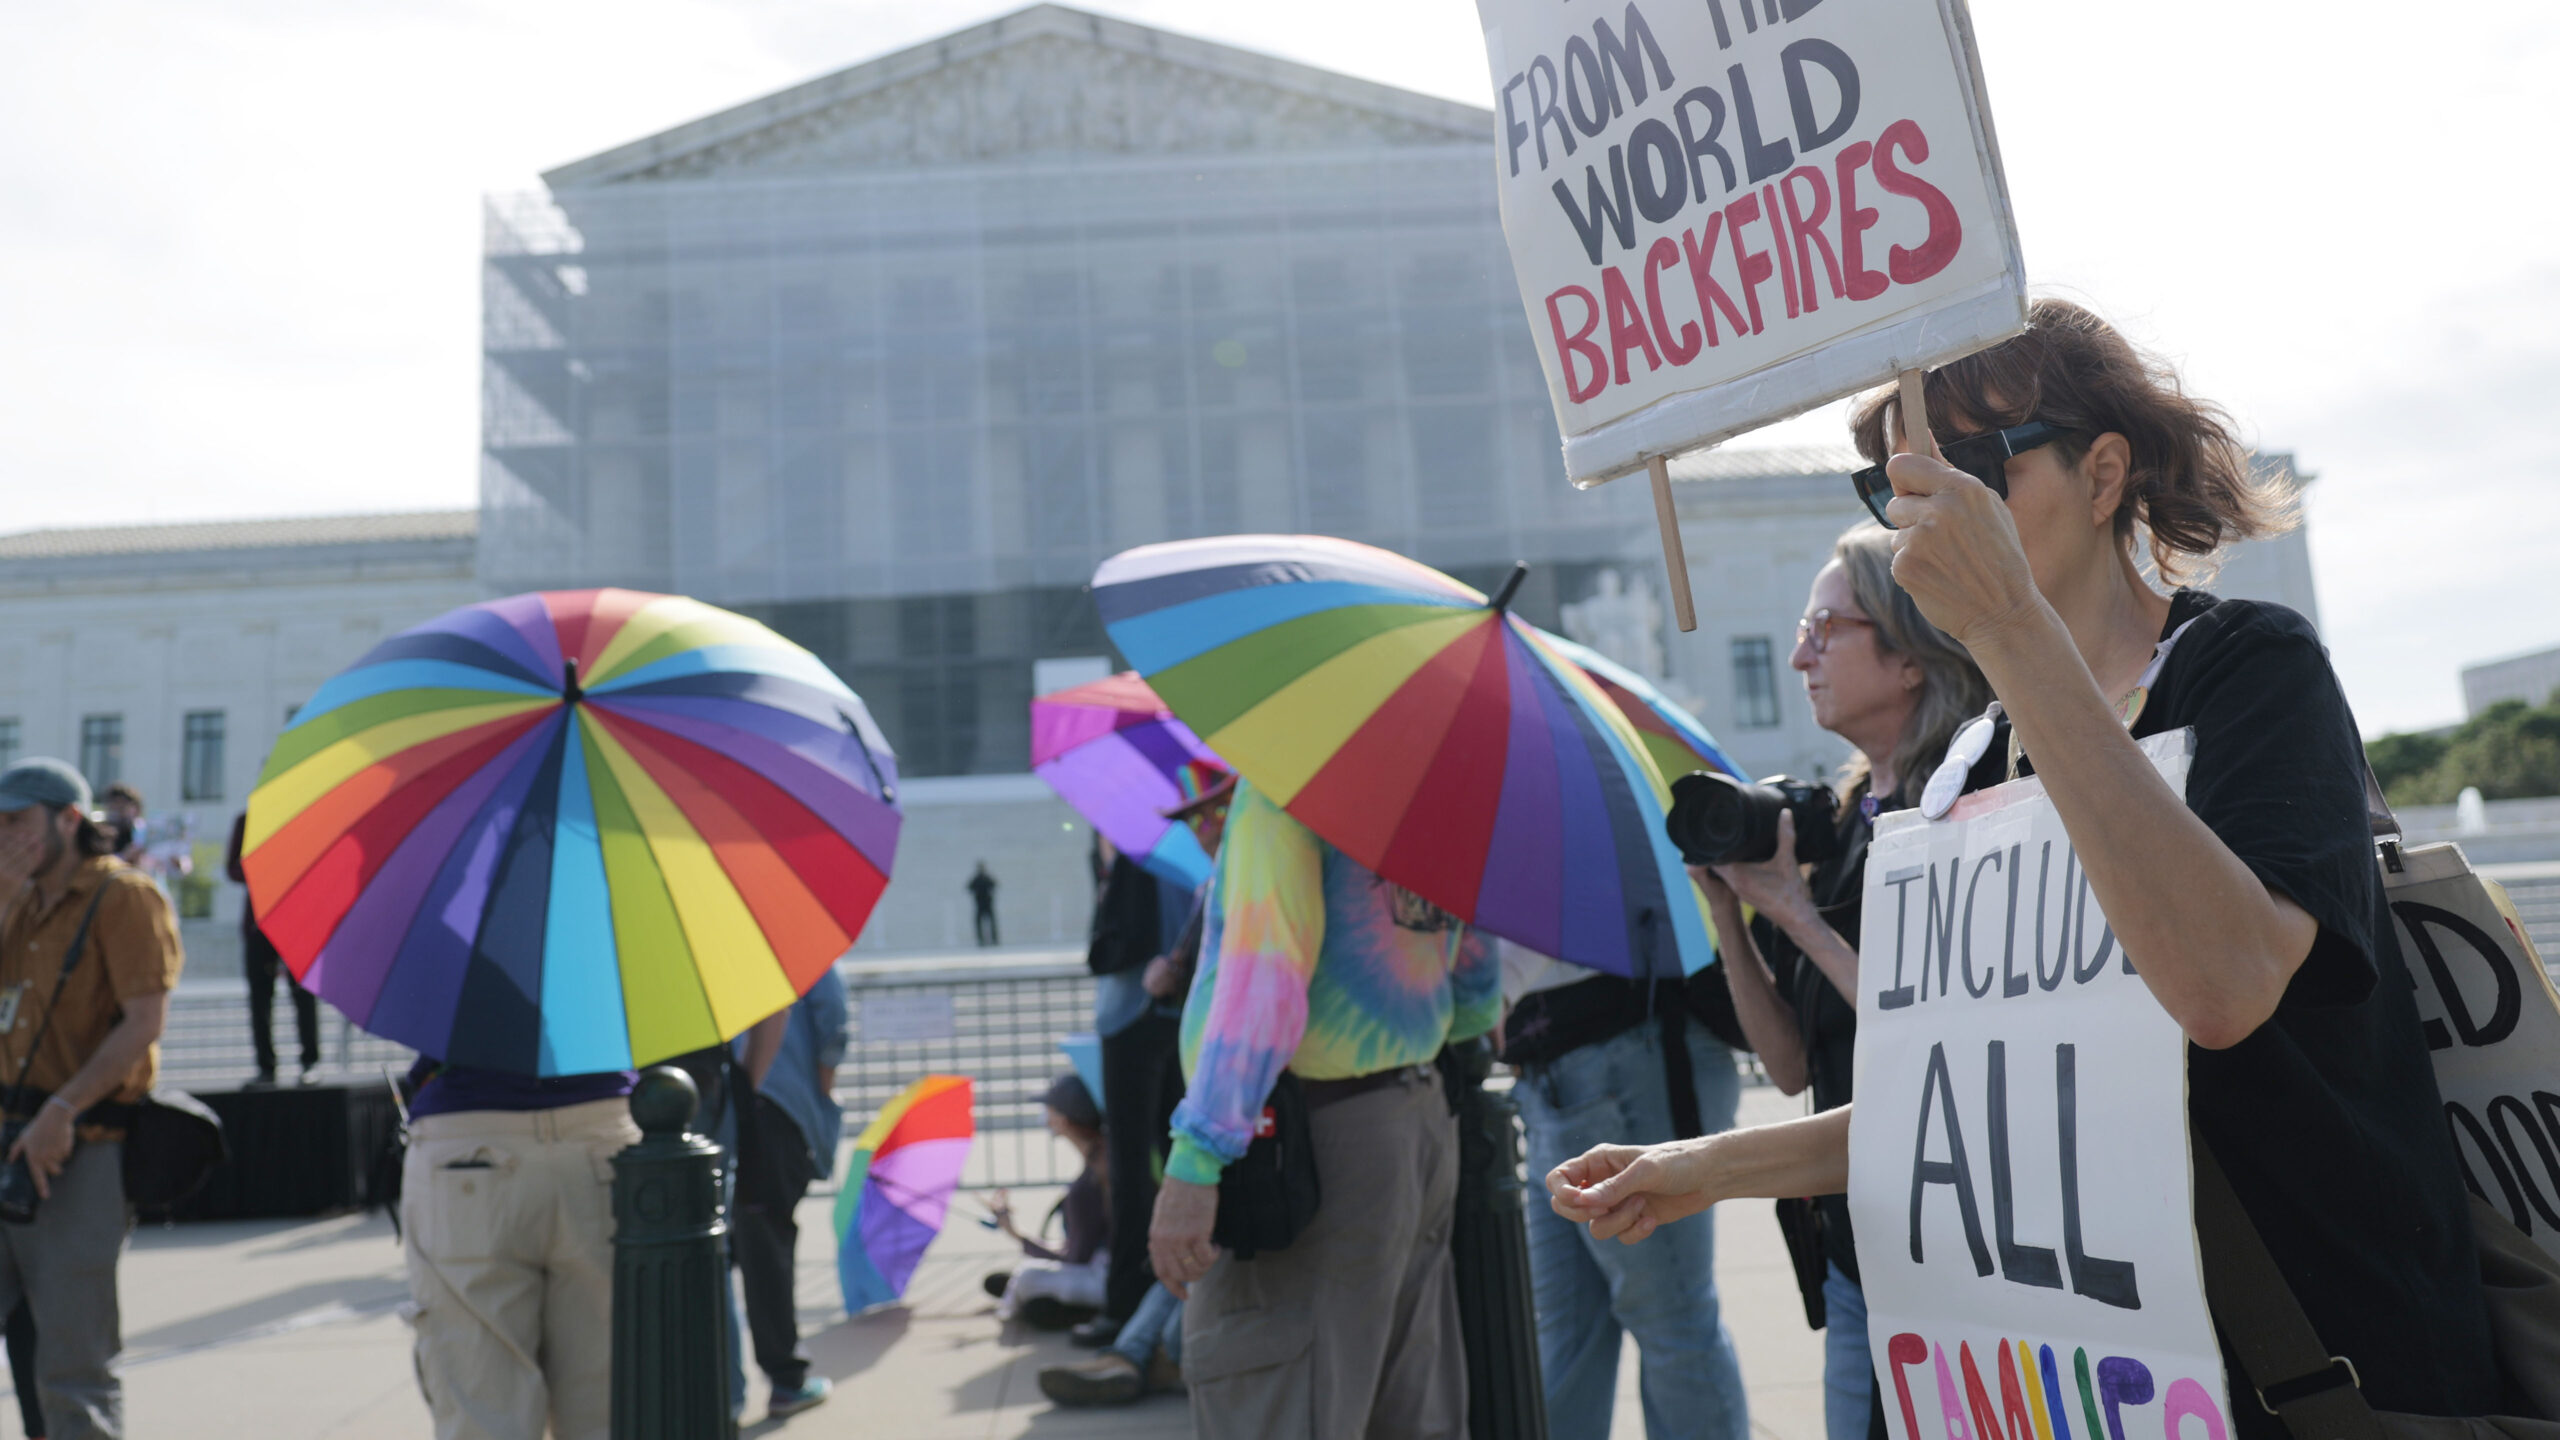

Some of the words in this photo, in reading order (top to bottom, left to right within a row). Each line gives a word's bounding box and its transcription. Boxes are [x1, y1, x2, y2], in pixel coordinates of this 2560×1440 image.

[1502, 1, 1675, 177] FROM
[1552, 38, 1860, 265] WORLD
[1545, 118, 1962, 403] BACKFIRES
[1879, 840, 2138, 1010] INCLUD
[1910, 1040, 2141, 1310] ALL
